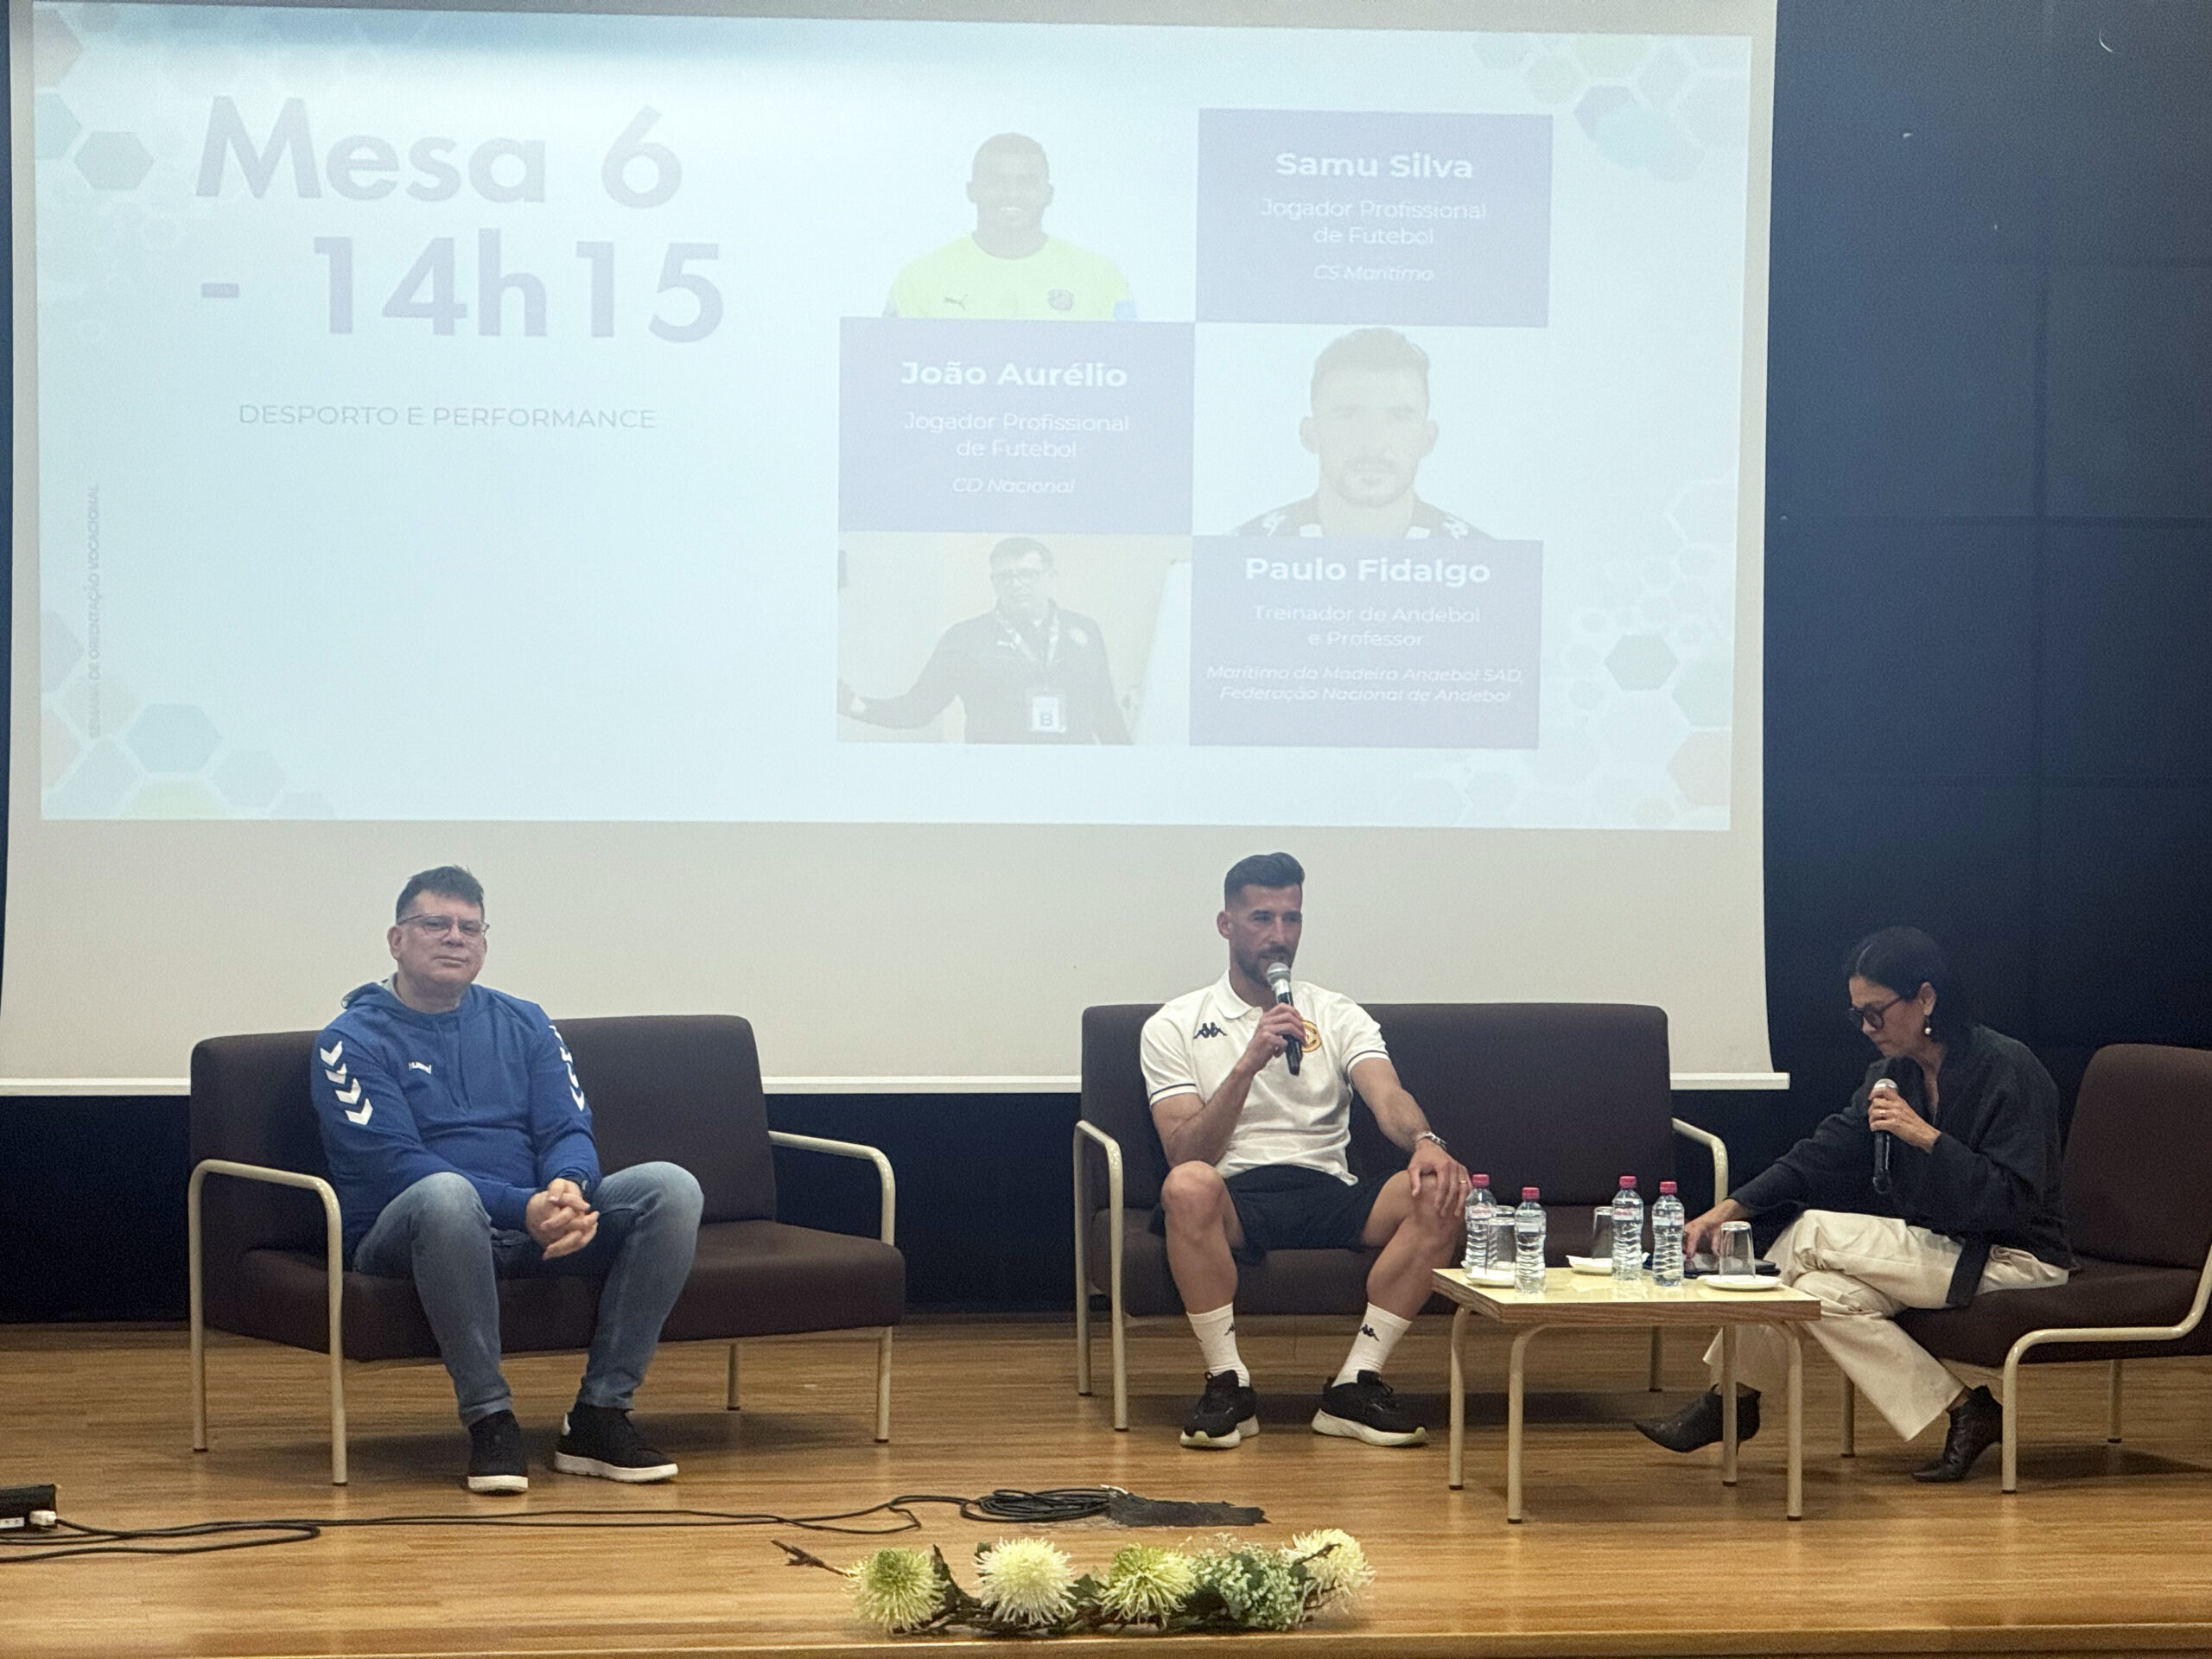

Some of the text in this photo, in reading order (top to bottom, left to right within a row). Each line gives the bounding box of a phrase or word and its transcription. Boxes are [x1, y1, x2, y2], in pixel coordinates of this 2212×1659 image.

[194, 94, 683, 208] Mesa 6
[1275, 152, 1473, 178] Samu Silva
[1261, 197, 1486, 220] Jogador Profissional
[1313, 226, 1434, 245] de Futebol
[1313, 264, 1340, 280] CS
[200, 228, 725, 344] - 14h15
[900, 360, 1128, 388] João Aurélio
[238, 404, 657, 429] DESPORTO E PERFORMANCE
[904, 411, 1129, 433] Jogador Profissional
[957, 439, 1077, 458] de Futebol
[952, 477, 1077, 494] CD Nacional
[1245, 556, 1491, 588] Paulo Fidalgo
[1254, 605, 1482, 624] Treinador de Andebol
[1307, 630, 1425, 648] e Professor
[1322, 666, 1399, 681] Madeira
[1402, 666, 1479, 683] Andebol
[1219, 685, 1513, 703] Federação Nacional de Andebol
